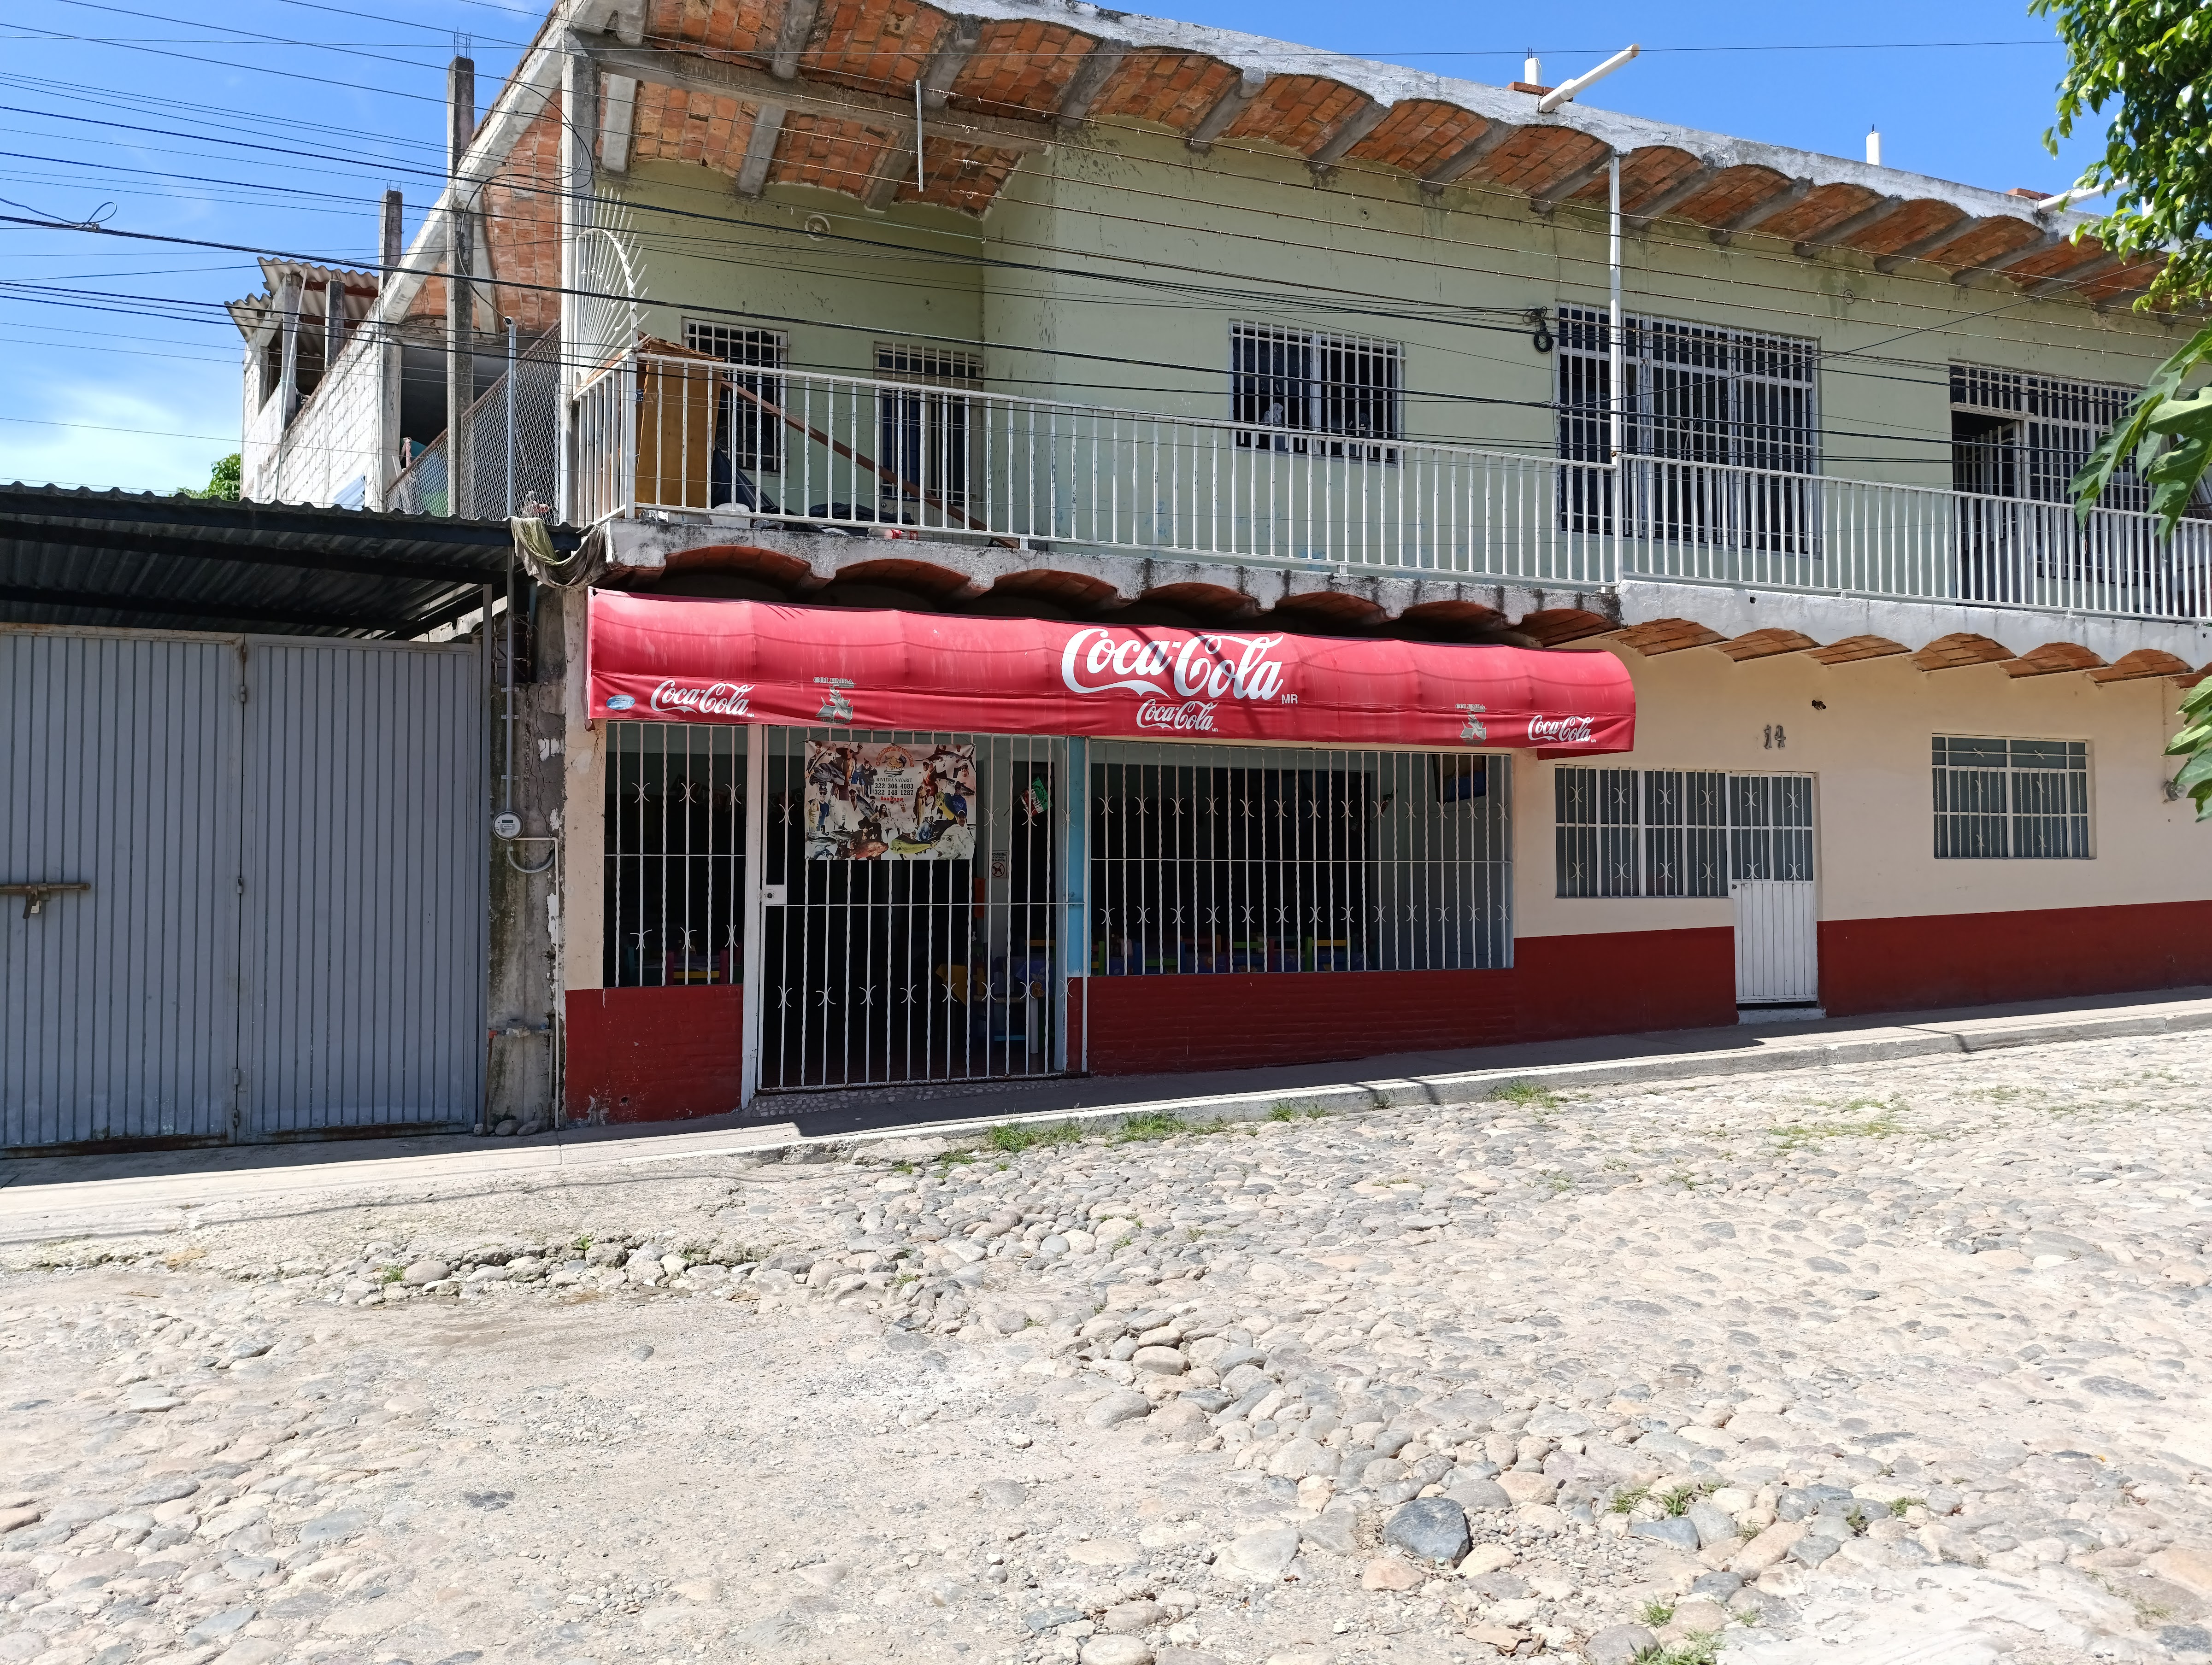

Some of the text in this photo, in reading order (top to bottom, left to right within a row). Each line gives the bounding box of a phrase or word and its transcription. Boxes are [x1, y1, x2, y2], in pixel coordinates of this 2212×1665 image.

[1061, 628, 1298, 704] Coca-Cola MR
[650, 680, 755, 715] Coca-Cola
[1136, 699, 1219, 731] Coca-Cola
[1528, 715, 1595, 742] Coca-Cola
[1764, 725, 1786, 749] 14
[901, 749, 914, 767] TOURS
